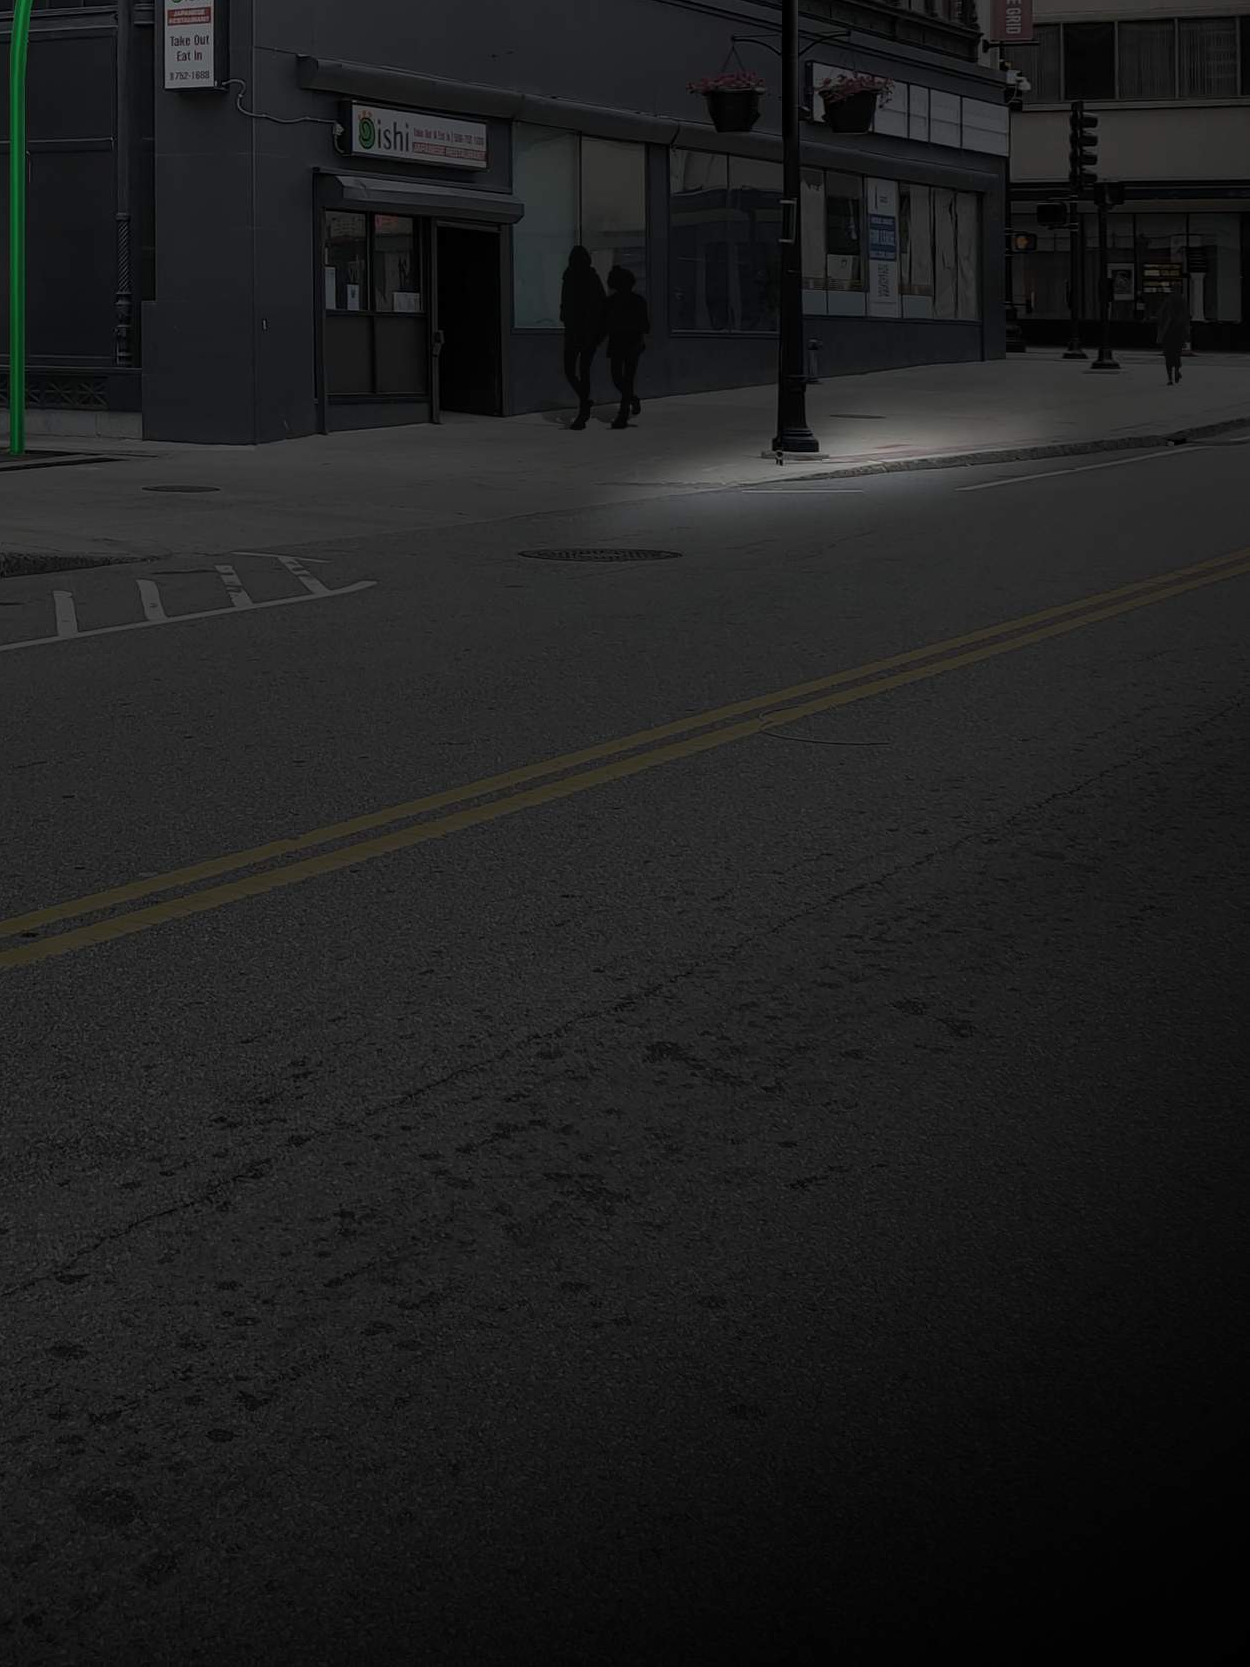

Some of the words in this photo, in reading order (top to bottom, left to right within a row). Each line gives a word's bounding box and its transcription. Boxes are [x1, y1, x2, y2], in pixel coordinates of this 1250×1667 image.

[1006, 7, 1022, 34] GRID
[170, 35, 191, 46] Take
[194, 34, 210, 45] Out
[176, 50, 191, 62] Eat
[194, 50, 203, 60] In
